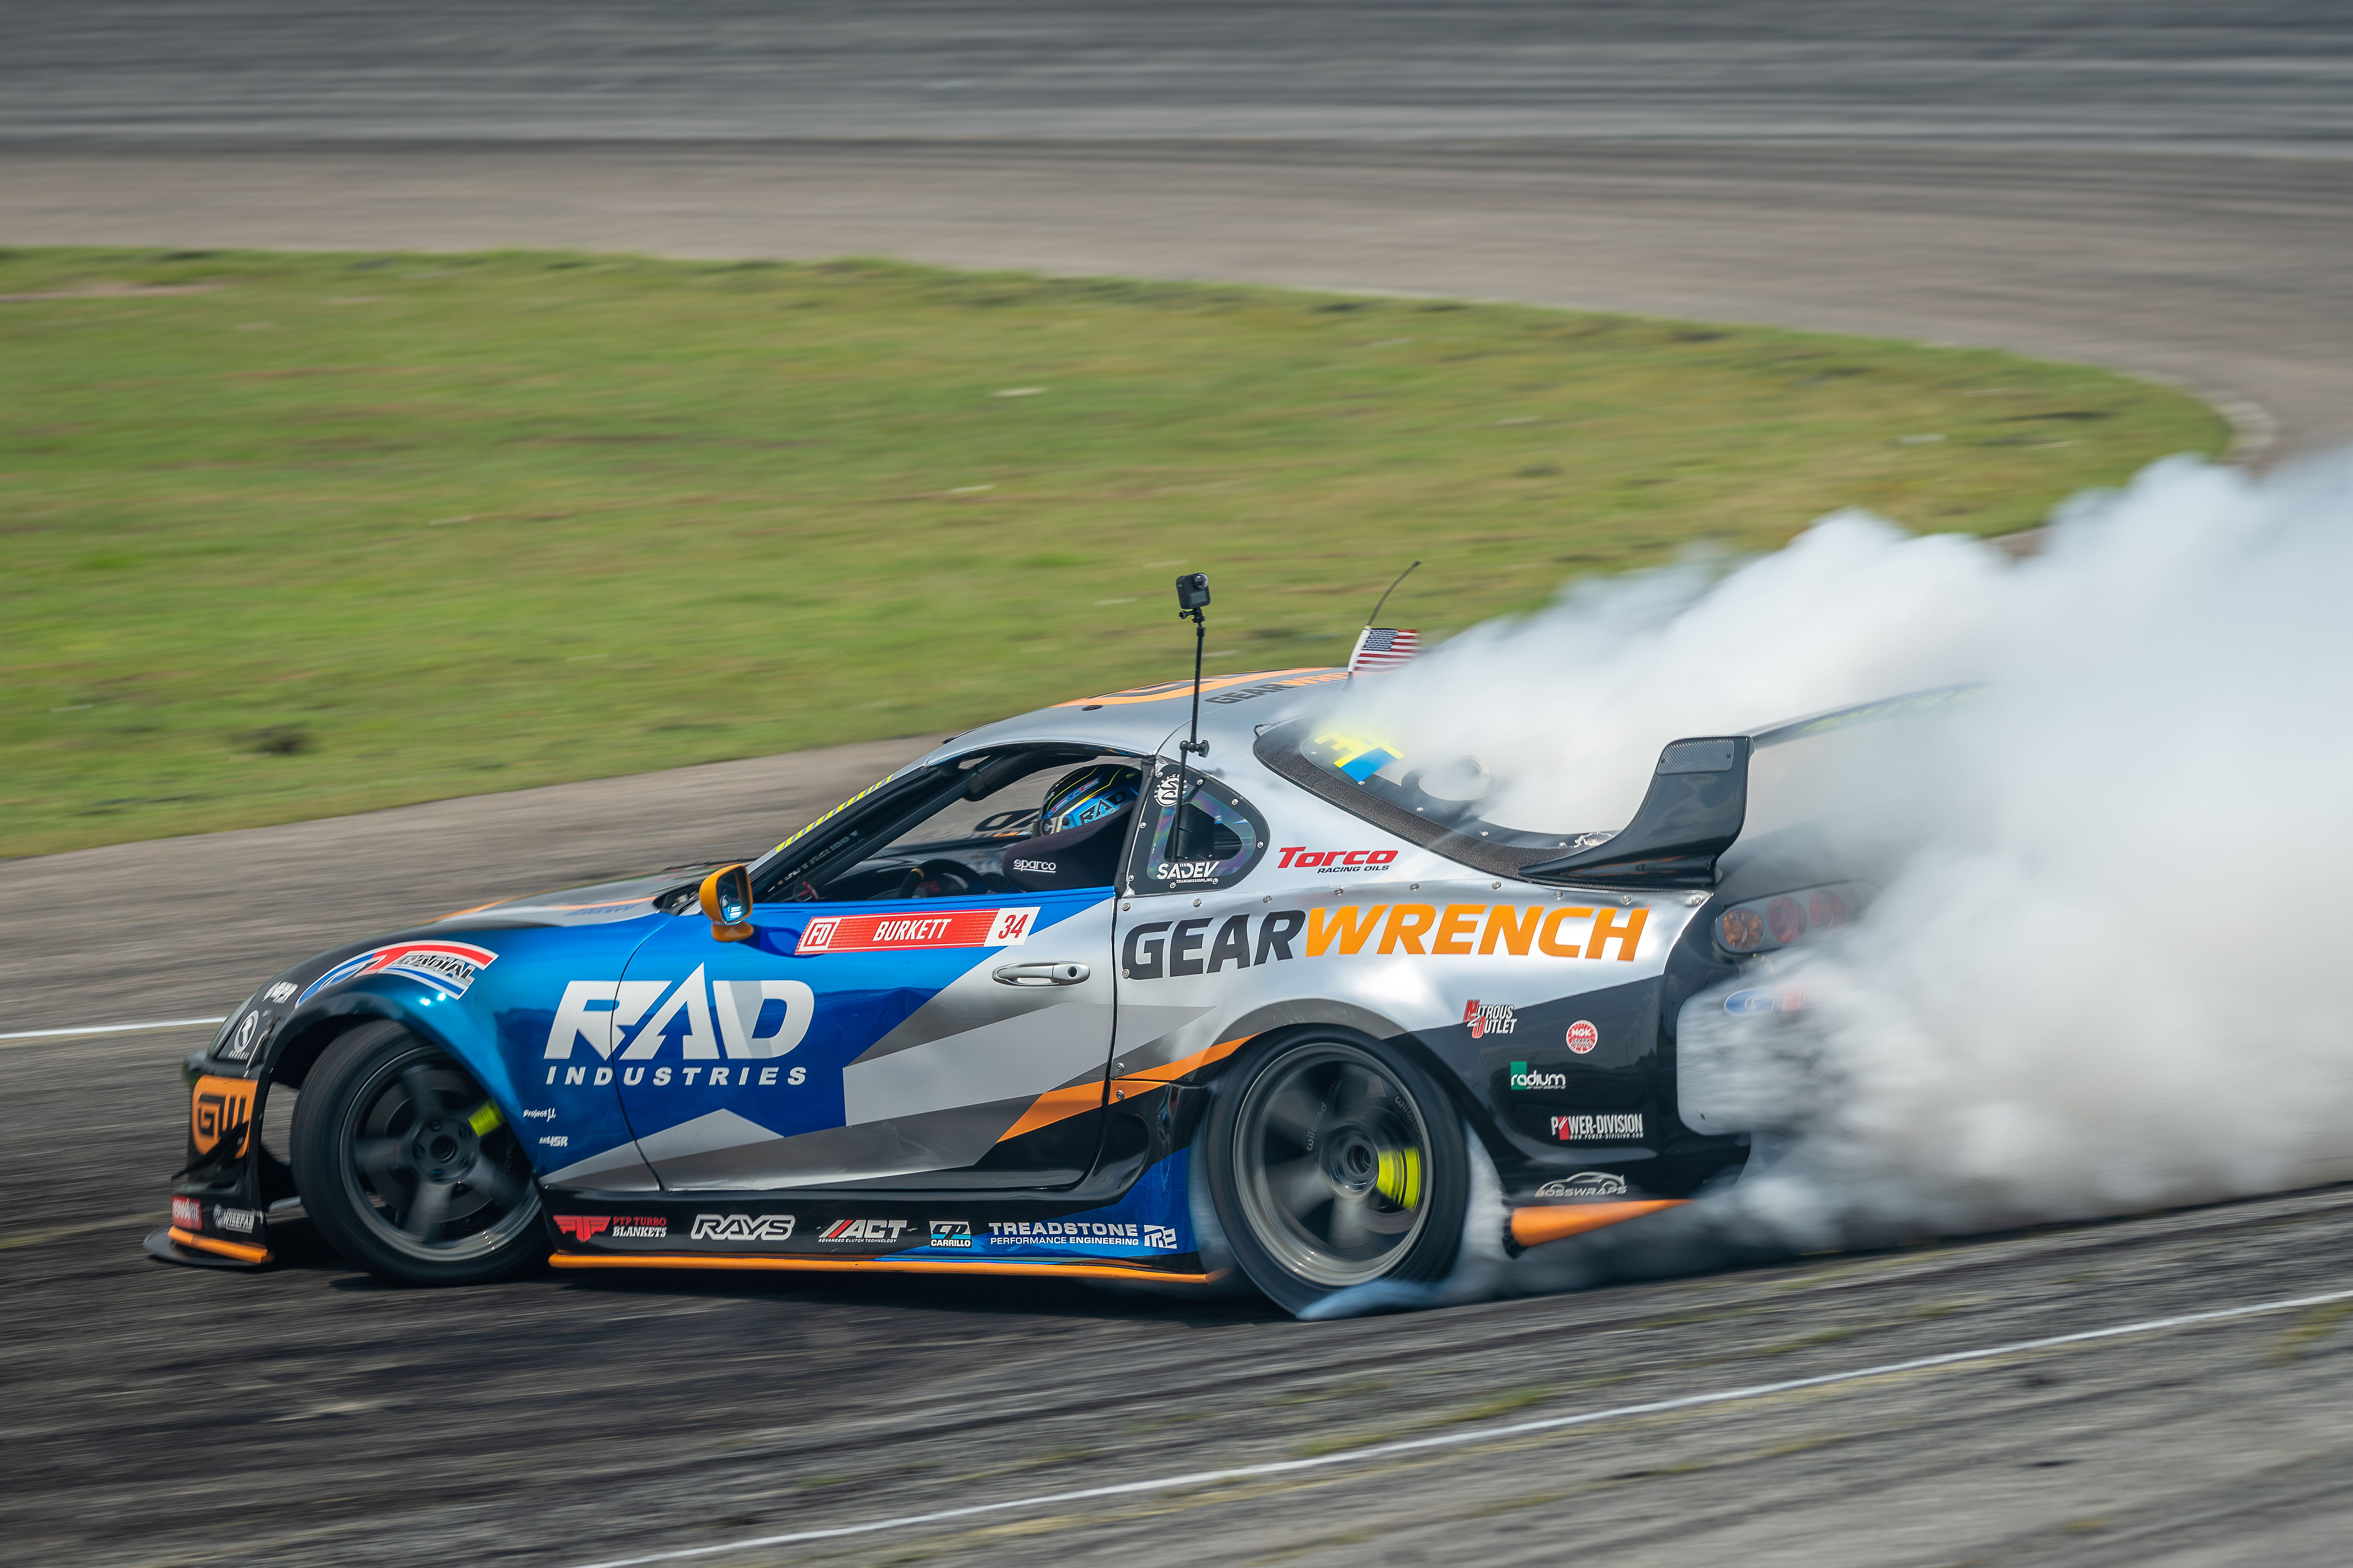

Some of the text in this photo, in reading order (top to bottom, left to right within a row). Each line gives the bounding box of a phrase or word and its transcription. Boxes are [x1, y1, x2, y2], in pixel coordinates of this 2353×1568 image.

[1014, 859, 1056, 872] sparco
[1278, 847, 1398, 868] Torco
[1157, 861, 1220, 879] SADEV
[807, 914, 1029, 945] FD BURKETT 34
[1122, 903, 1650, 980] GEARWRENCH
[543, 962, 815, 1060] RAD
[1571, 1028, 1591, 1037] NGK
[546, 1066, 806, 1085] INDUSTRIES
[1511, 1070, 1566, 1086] radium
[1535, 1185, 1627, 1197] BOSSWRAPS
[634, 1217, 667, 1226] TURBO
[690, 1214, 796, 1240] RAYS
[989, 1222, 1138, 1236] TREADSTONE
[612, 1226, 667, 1238] BLANKETS
[991, 1236, 1138, 1245] PERFORMANCE ENGINEERING
